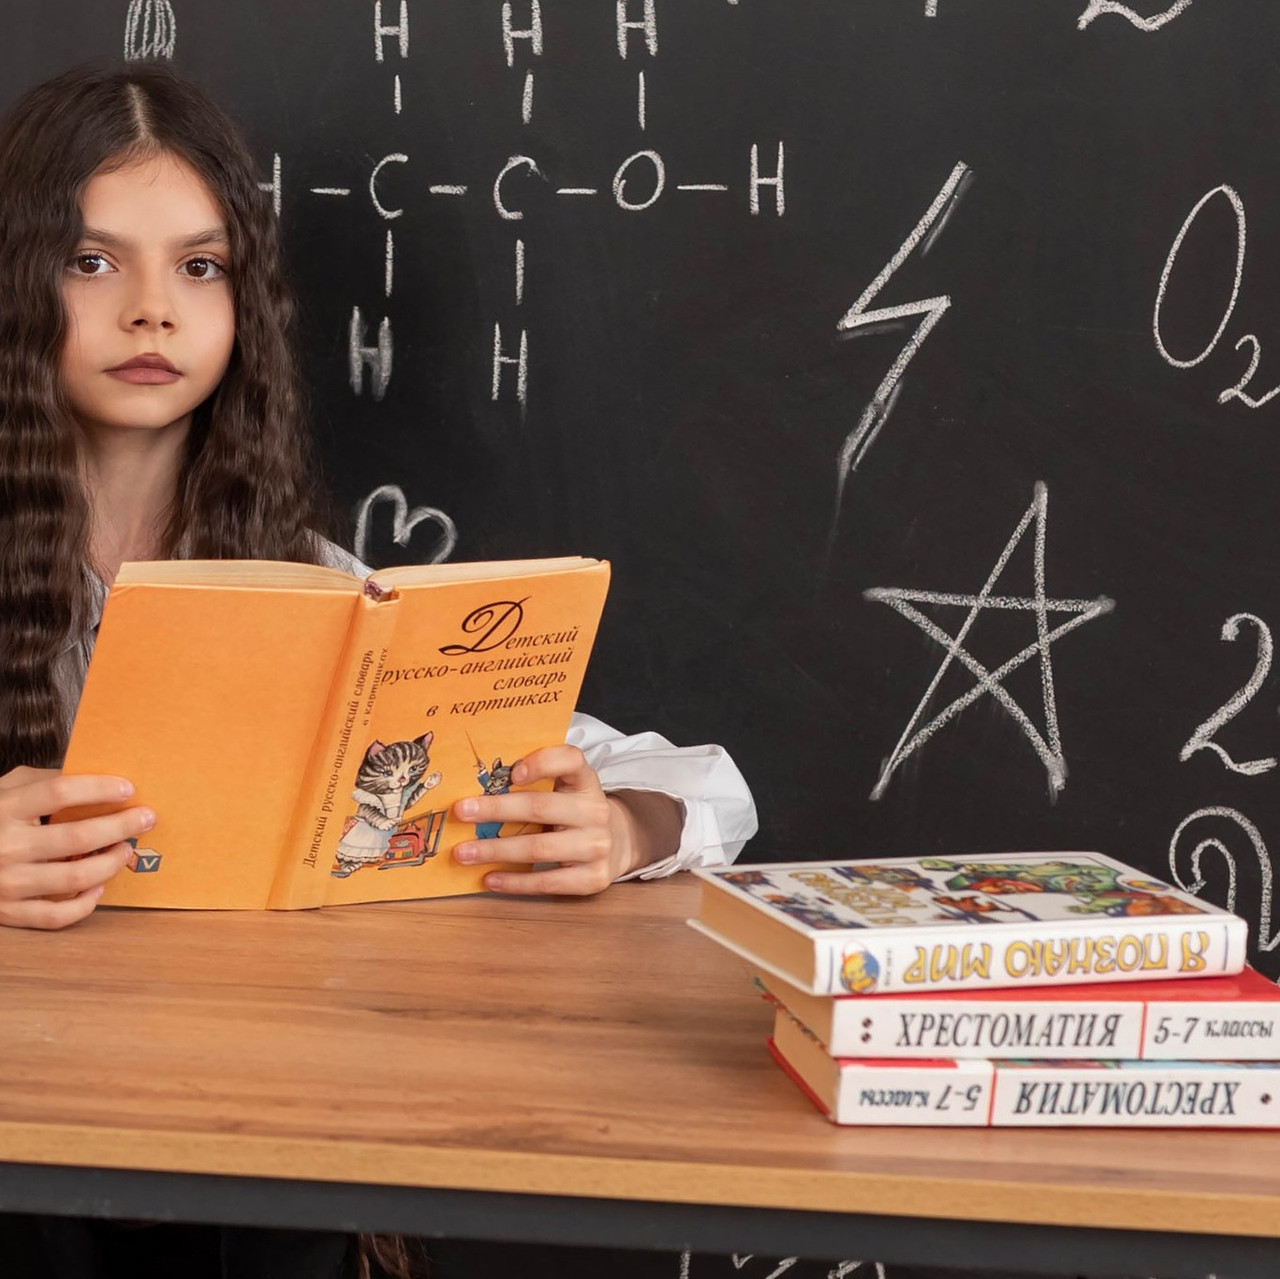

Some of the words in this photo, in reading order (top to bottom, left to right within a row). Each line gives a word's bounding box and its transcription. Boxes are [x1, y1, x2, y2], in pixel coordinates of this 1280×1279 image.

[438, 596, 580, 656] Детский
[380, 647, 574, 685] русско-английский
[493, 672, 567, 691] словарь
[426, 704, 439, 717] в
[450, 688, 563, 716] картинках
[1179, 612, 1278, 774] 2
[302, 816, 328, 869] Детский
[323, 703, 360, 813] русско-английский
[354, 649, 375, 696] словарь
[903, 943, 993, 984] МИР
[1005, 932, 1169, 979] ПОЗНАЮ
[1179, 931, 1210, 971] Я
[895, 1013, 1124, 1048] ХРЕСТОМАТИЯ
[1153, 1020, 1198, 1044] 5-7
[1204, 1018, 1274, 1038] классы
[859, 1089, 929, 1108] классы
[935, 1085, 982, 1111] 5-7
[1013, 1081, 1241, 1115] ХРЕСТОМАТИЯ
